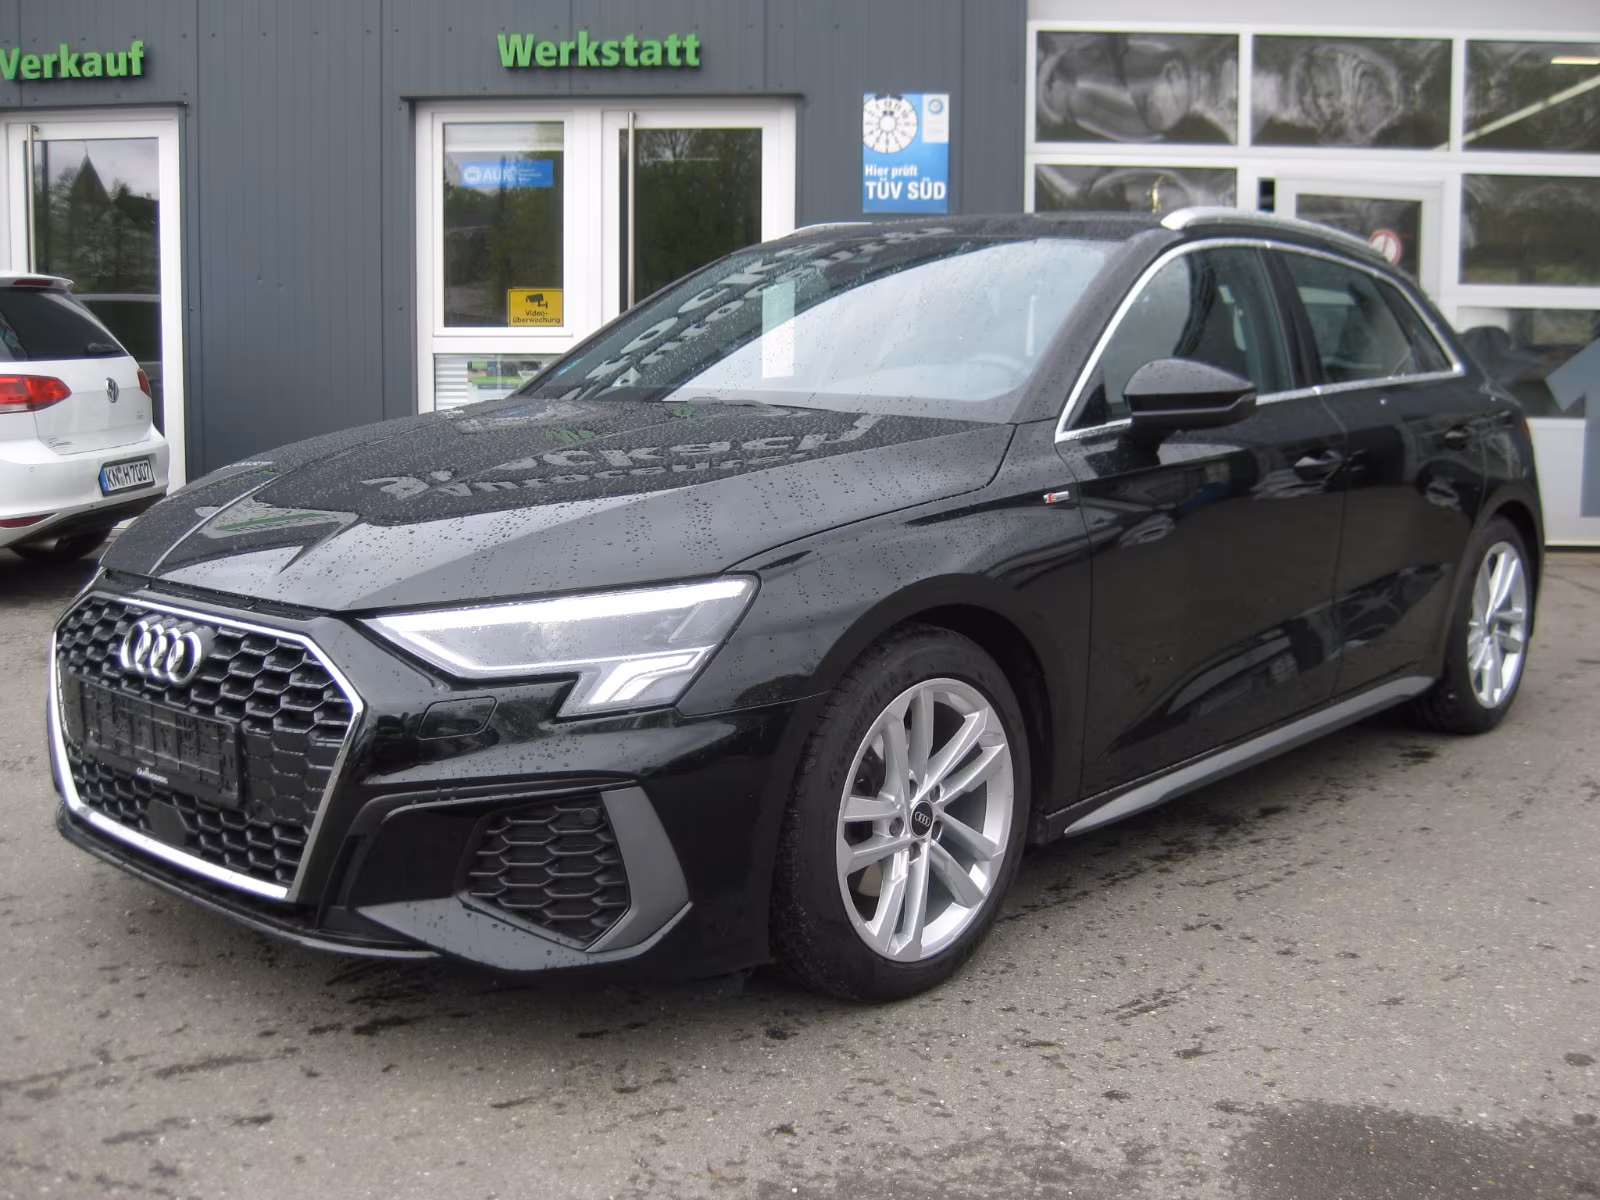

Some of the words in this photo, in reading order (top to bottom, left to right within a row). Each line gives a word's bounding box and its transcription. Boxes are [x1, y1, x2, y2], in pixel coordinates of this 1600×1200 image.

[497, 31, 700, 67] Werkstatt
[0, 41, 144, 80] Verkauf
[865, 165, 889, 177] Hier
[865, 178, 903, 200] TÜV
[907, 177, 946, 200] SÜD
[513, 316, 560, 324] überwachung
[526, 309, 548, 317] Video-
[105, 467, 120, 489] KN
